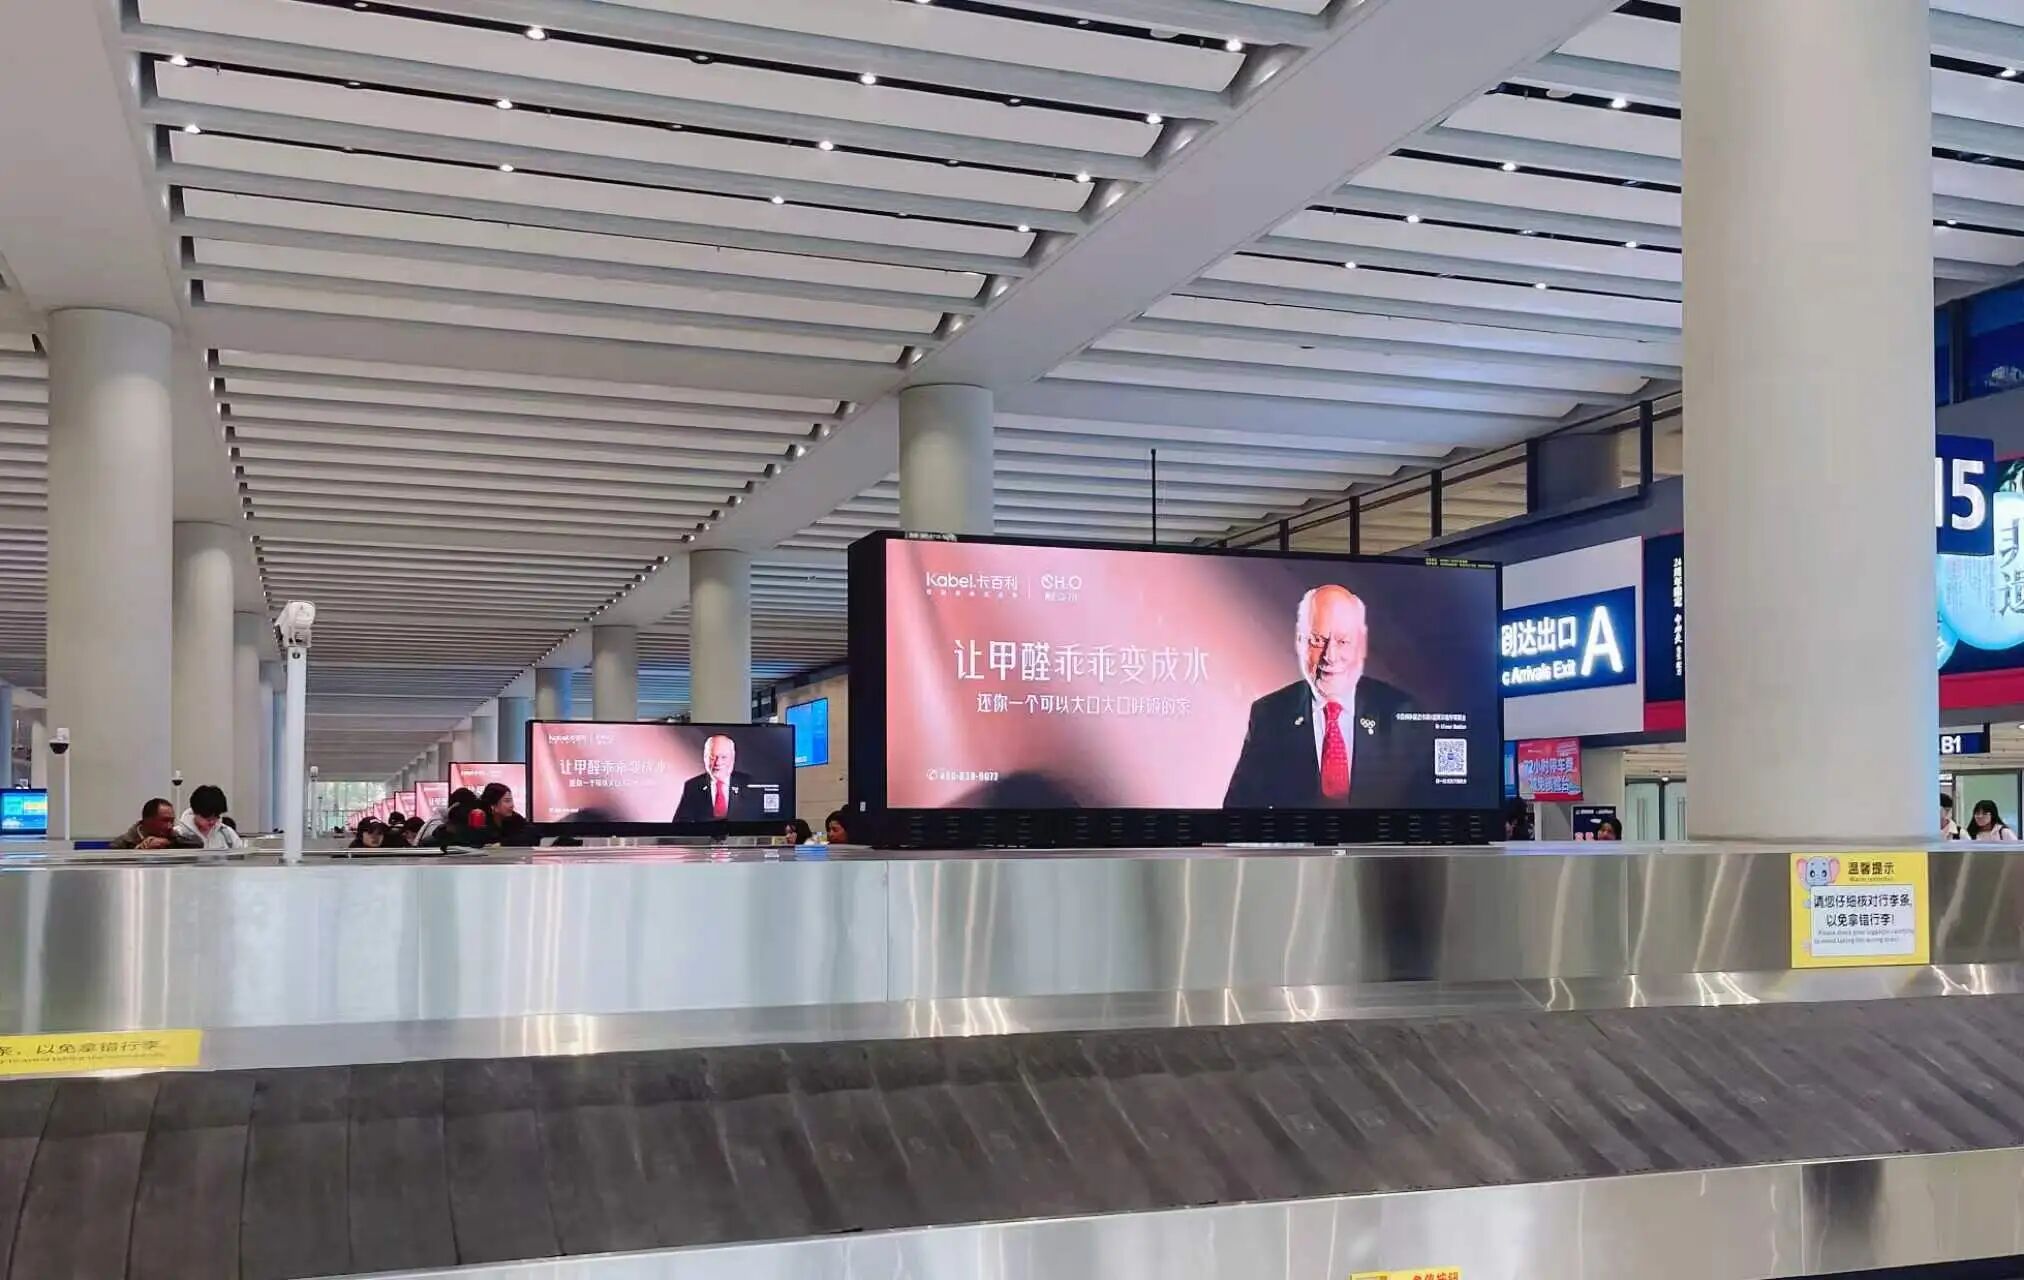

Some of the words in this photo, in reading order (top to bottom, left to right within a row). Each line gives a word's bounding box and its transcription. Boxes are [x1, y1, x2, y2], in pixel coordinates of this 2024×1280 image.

[1580, 605, 1624, 677] A
[954, 639, 1210, 685] 让甲醛乖乖变成水
[1553, 659, 1577, 679] Exit
[1941, 735, 1961, 754] B1
